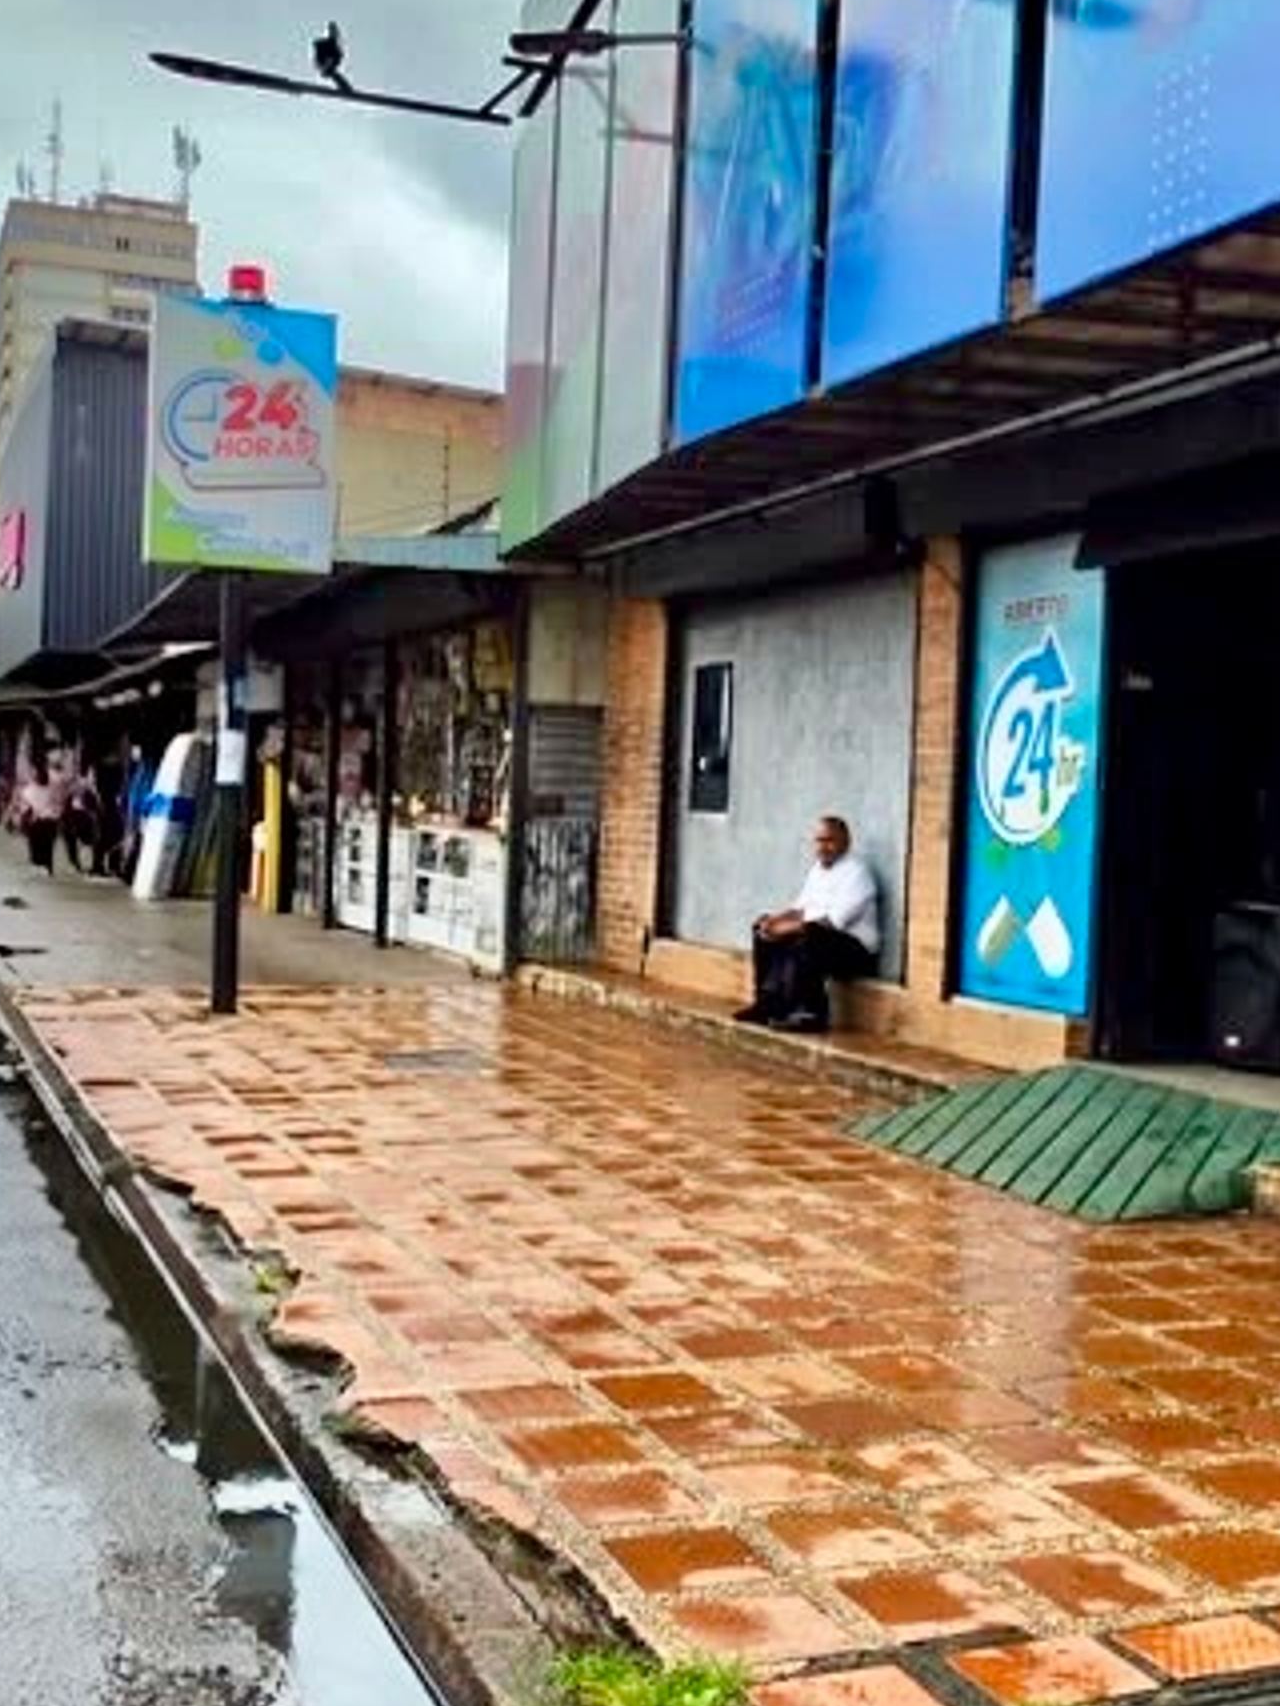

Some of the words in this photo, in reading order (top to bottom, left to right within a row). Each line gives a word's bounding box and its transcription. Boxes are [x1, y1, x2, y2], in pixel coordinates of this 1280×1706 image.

[222, 379, 299, 432] 24
[213, 432, 320, 461] HORAS
[1002, 699, 1055, 814] 24
